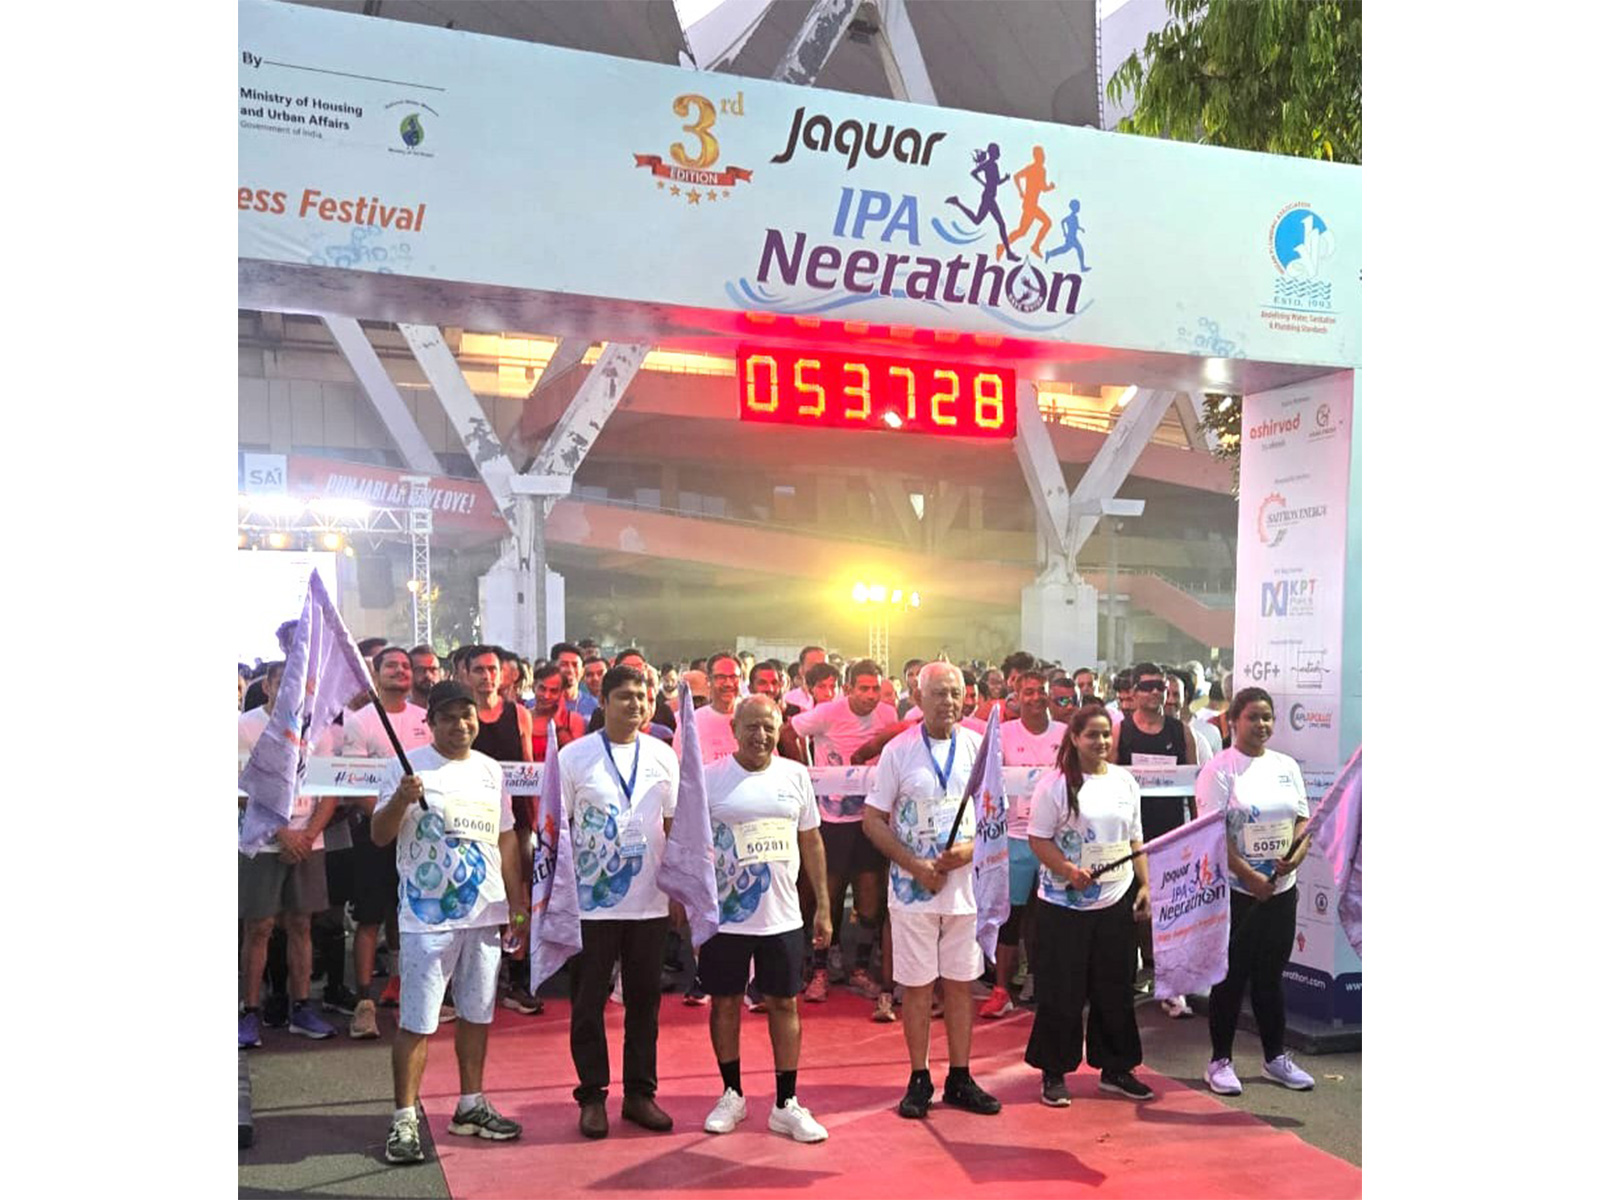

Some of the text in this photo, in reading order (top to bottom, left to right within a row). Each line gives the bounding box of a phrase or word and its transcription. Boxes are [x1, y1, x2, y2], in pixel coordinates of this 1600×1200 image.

[242, 52, 262, 68] By
[240, 88, 292, 107] Ministry
[296, 98, 309, 108] of
[313, 98, 363, 118] Housing
[240, 107, 350, 130] and Urban Affairs
[240, 120, 323, 139] Government of India
[670, 167, 718, 184] EDITION
[299, 189, 426, 232] Festival
[833, 186, 922, 246] IPA
[757, 228, 1083, 314] Neerathon
[746, 354, 1004, 428] 053728
[1250, 413, 1301, 439] ashirvad
[1290, 579, 1316, 596] KPT
[1159, 885, 1226, 922] Neerathon
[1171, 883, 1188, 903] IPA
